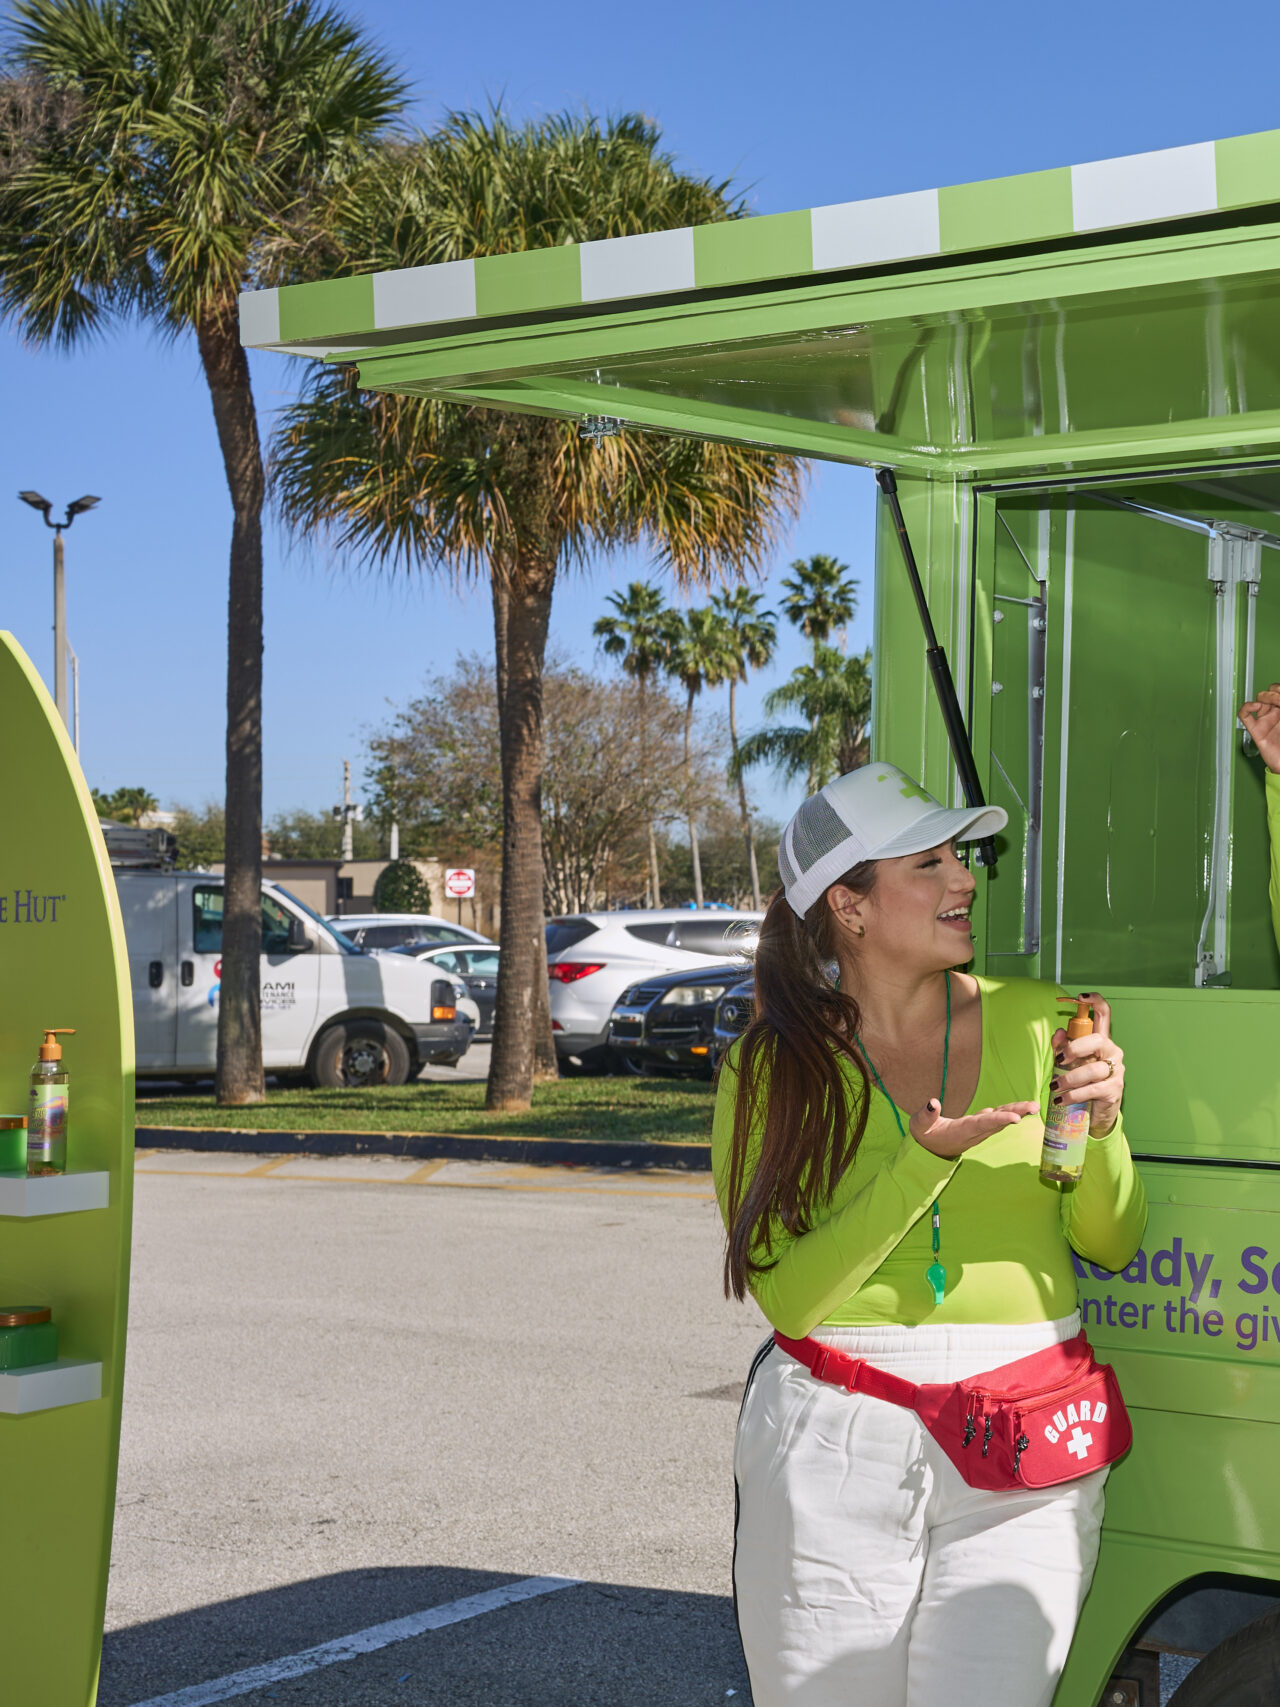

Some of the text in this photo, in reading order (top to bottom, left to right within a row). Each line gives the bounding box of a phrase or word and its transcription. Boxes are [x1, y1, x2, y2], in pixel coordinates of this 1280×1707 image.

[1078, 1289, 1155, 1330] nter
[1164, 1296, 1224, 1337] the
[1044, 1400, 1108, 1444] GUARD
